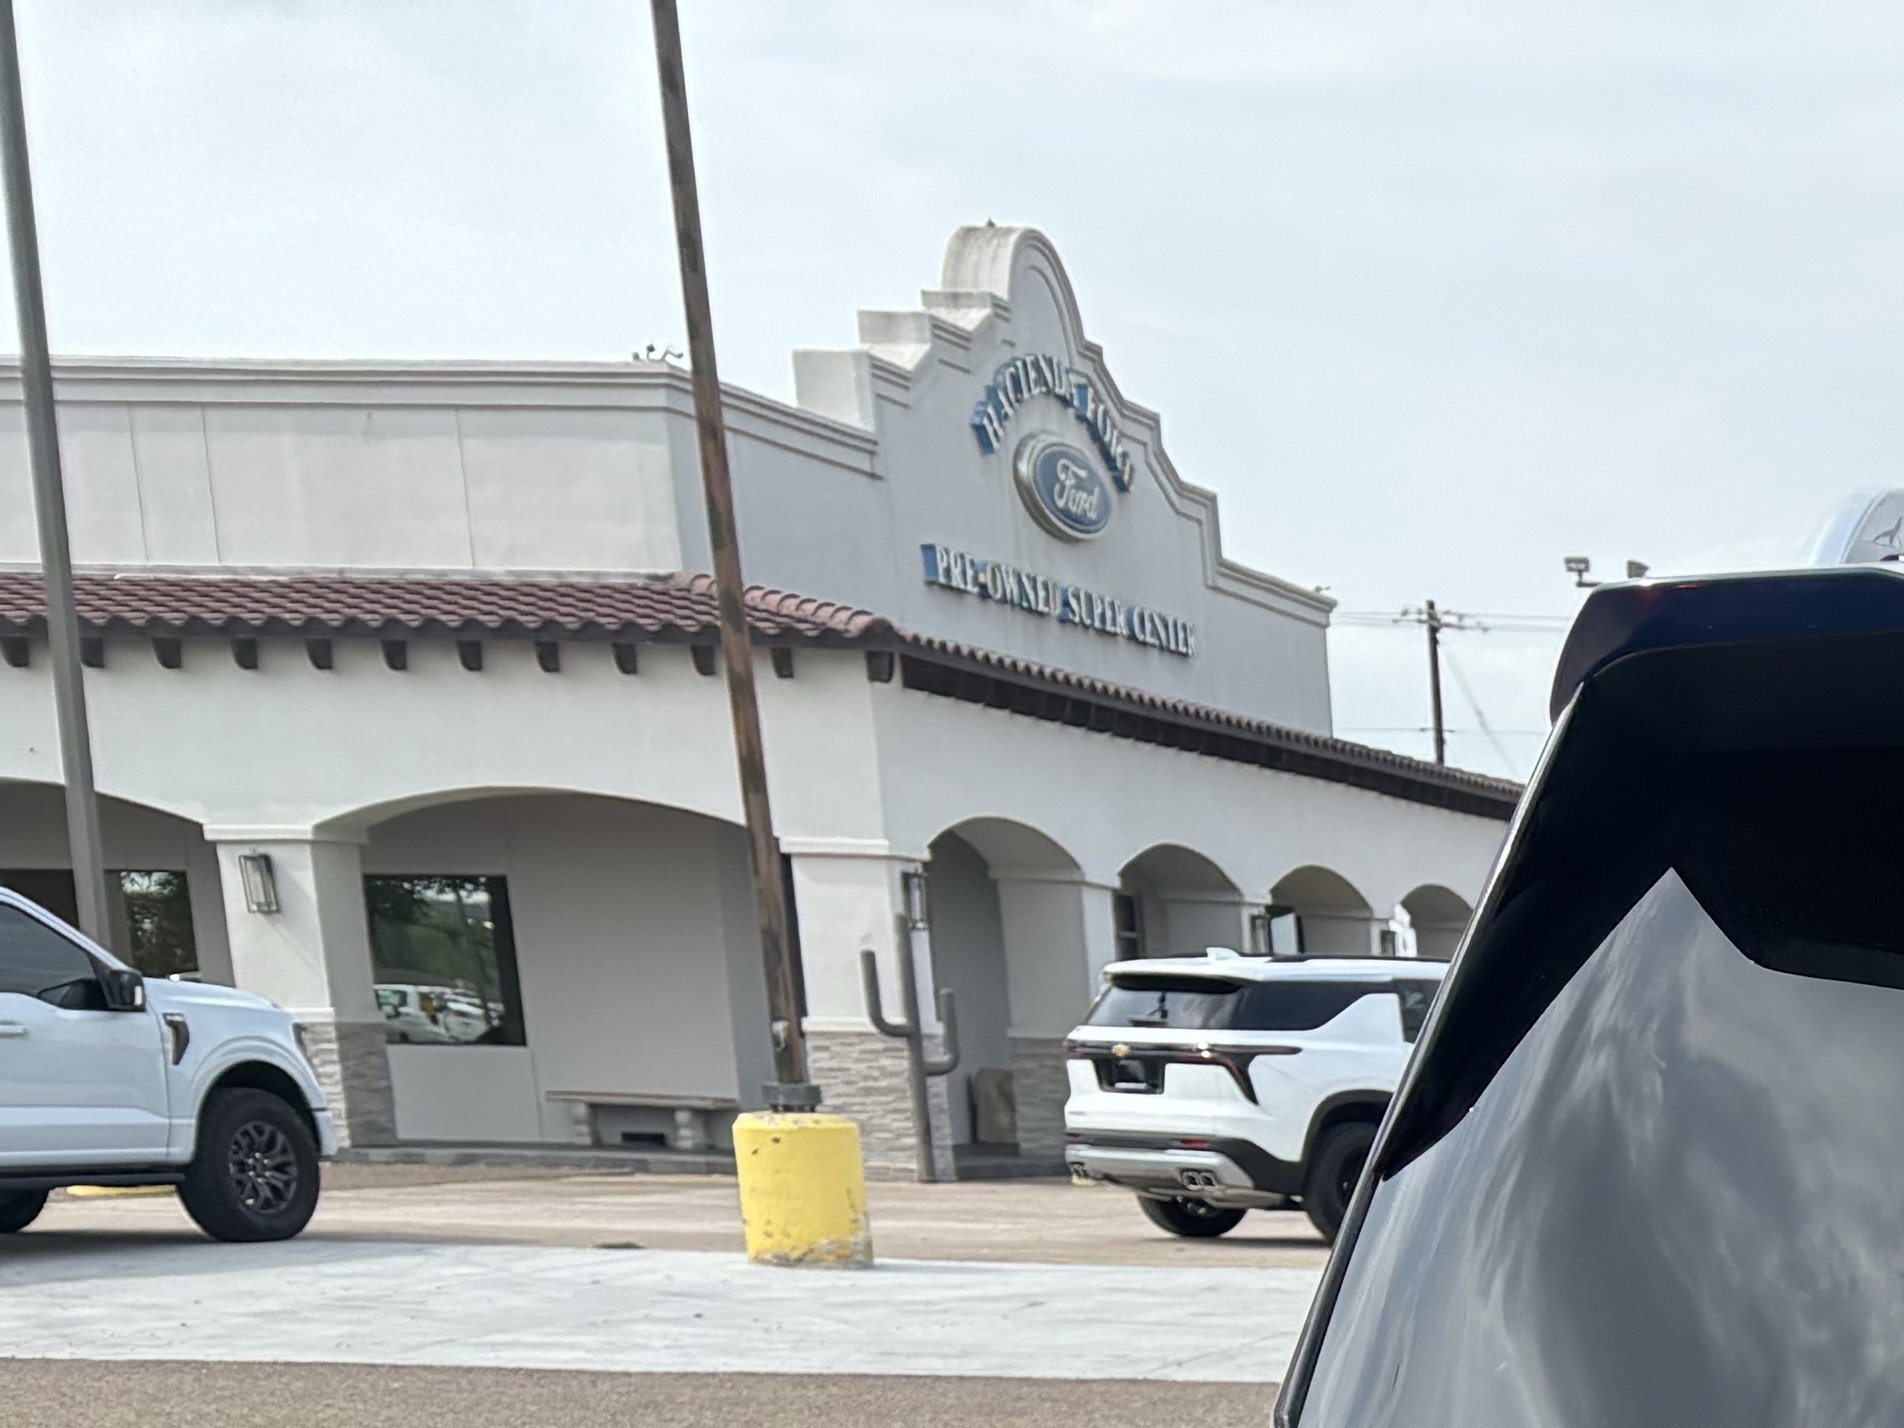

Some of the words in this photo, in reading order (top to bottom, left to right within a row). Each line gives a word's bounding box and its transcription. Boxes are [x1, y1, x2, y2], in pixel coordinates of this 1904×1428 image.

[1054, 458, 1100, 520] Ford
[931, 546, 1060, 616] PRE-OWNED
[1064, 585, 1128, 634] SUPER
[1132, 606, 1197, 657] CENTER
